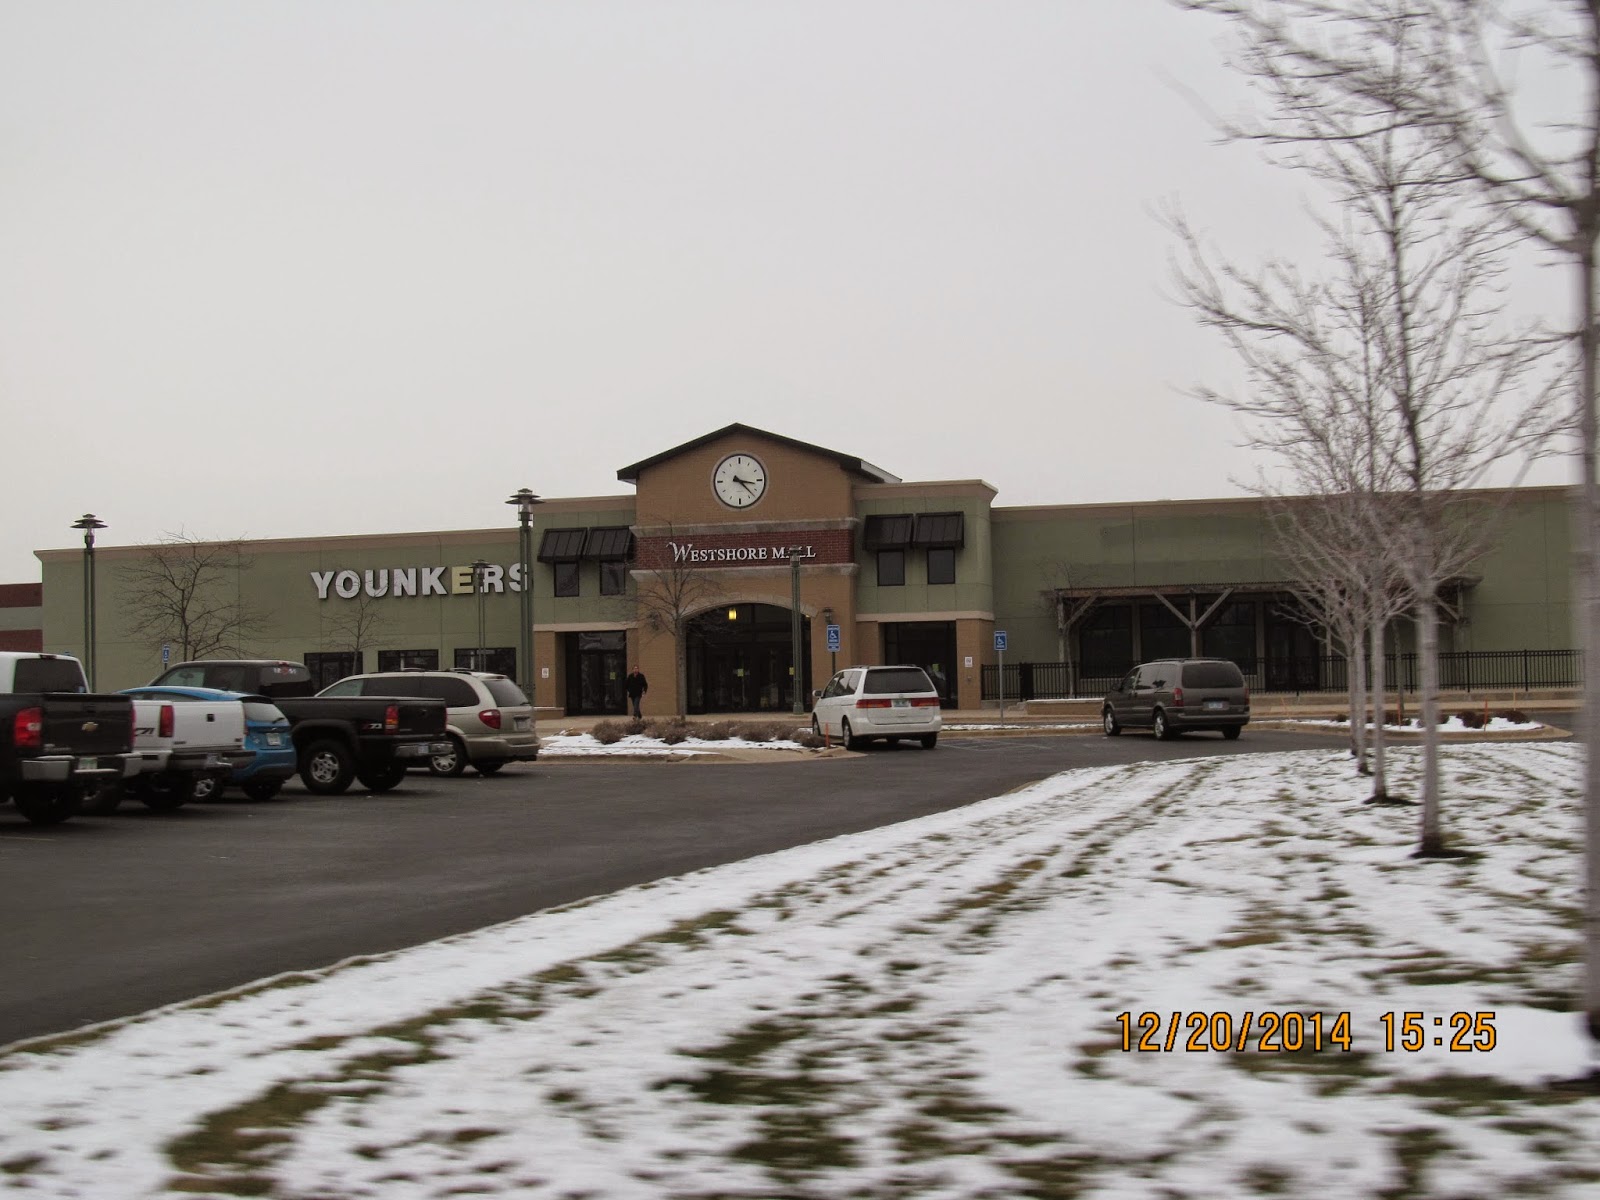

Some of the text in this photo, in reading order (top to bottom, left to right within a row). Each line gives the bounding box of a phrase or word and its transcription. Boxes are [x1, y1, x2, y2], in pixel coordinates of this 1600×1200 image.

[666, 541, 817, 562] WESTSHORE ML
[310, 562, 528, 599] YOUNKERS
